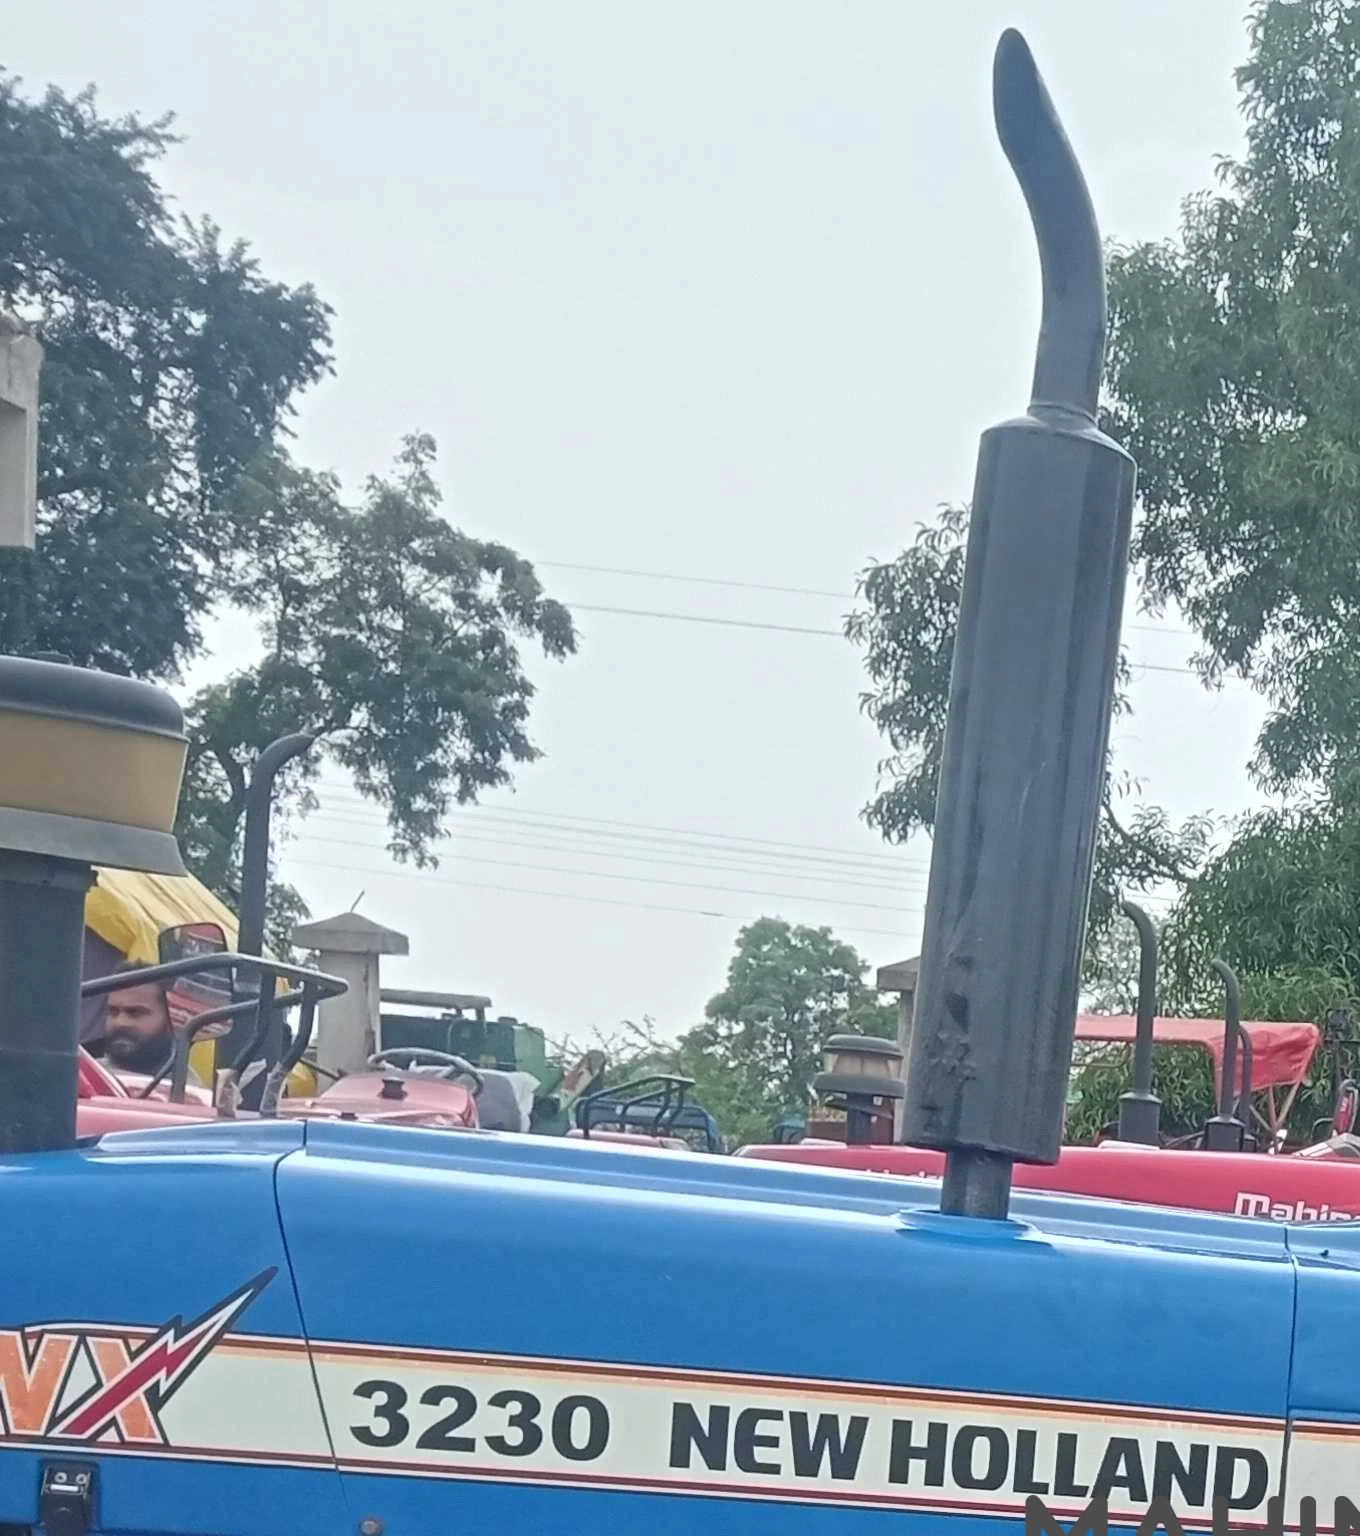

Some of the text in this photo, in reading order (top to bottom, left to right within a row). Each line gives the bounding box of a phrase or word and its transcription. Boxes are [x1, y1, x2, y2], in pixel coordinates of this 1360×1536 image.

[349, 1379, 1269, 1511] 3230 NEW HOLLAND
